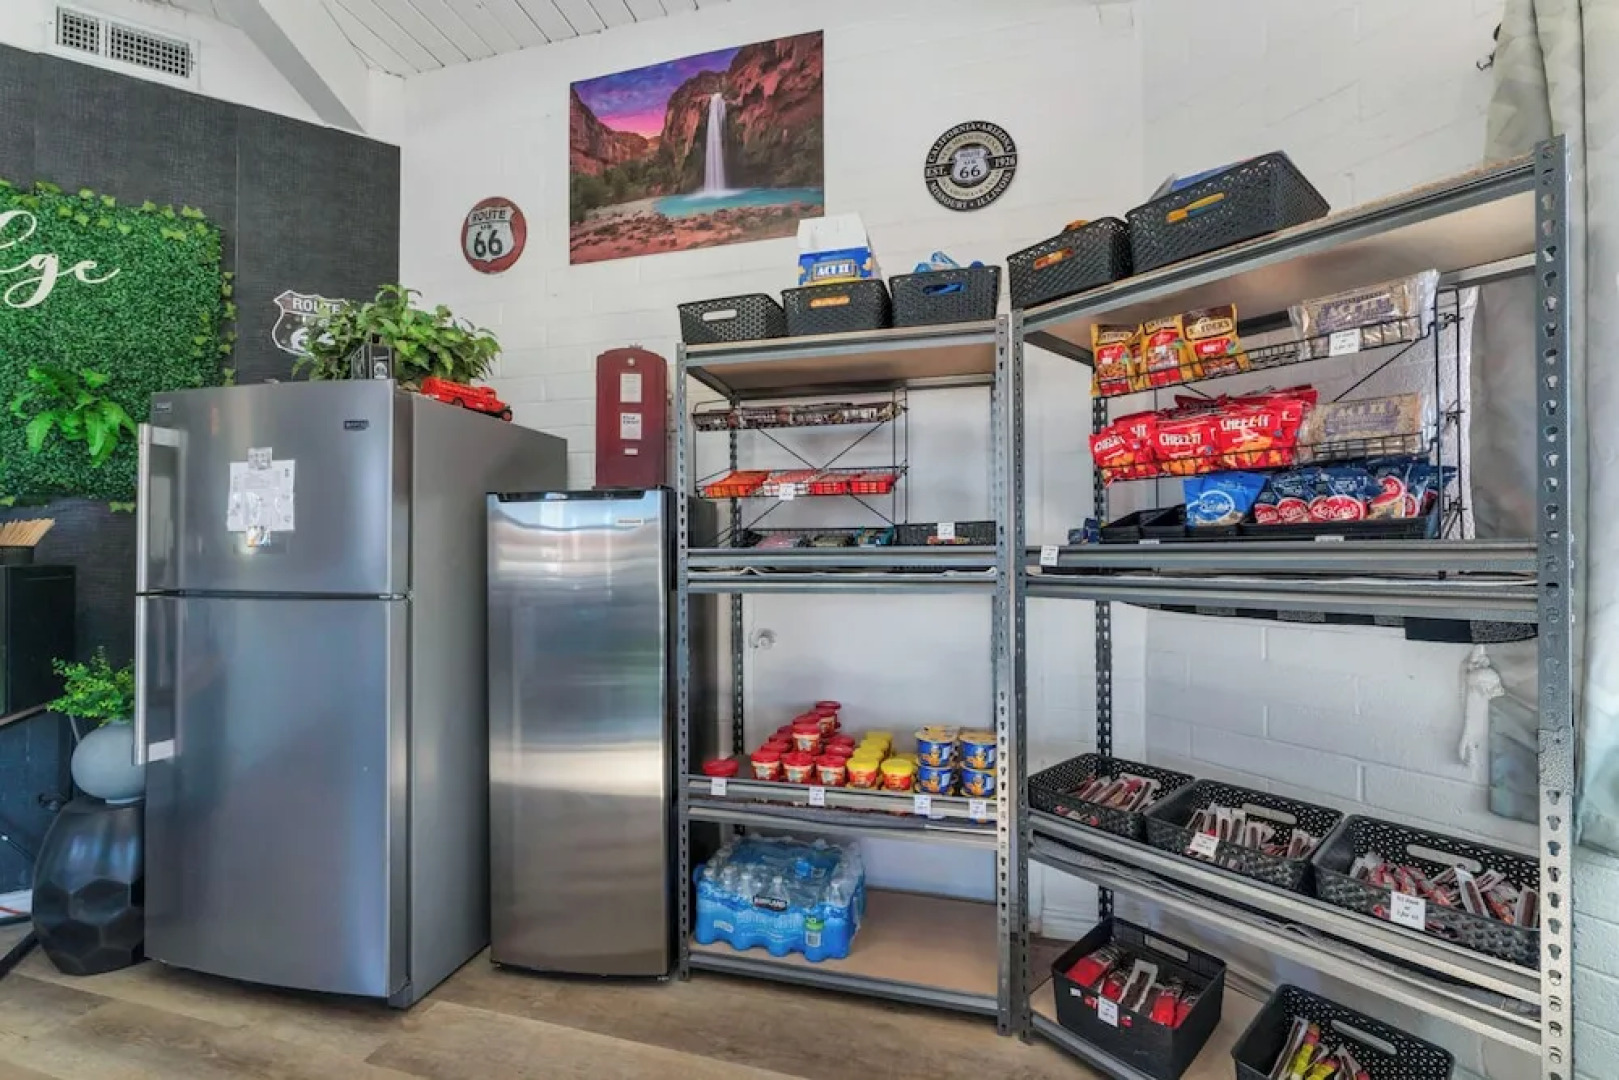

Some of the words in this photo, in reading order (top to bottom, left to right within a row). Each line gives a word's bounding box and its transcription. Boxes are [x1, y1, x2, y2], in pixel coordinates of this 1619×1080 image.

[929, 122, 977, 164] CALIFORNIA
[982, 122, 1014, 153] ARIZONA
[959, 164, 981, 179] 66
[930, 181, 968, 209] MISSOURI
[977, 171, 1012, 207] ILLINOIS
[472, 209, 506, 222] ROUTE
[474, 229, 503, 258] 66
